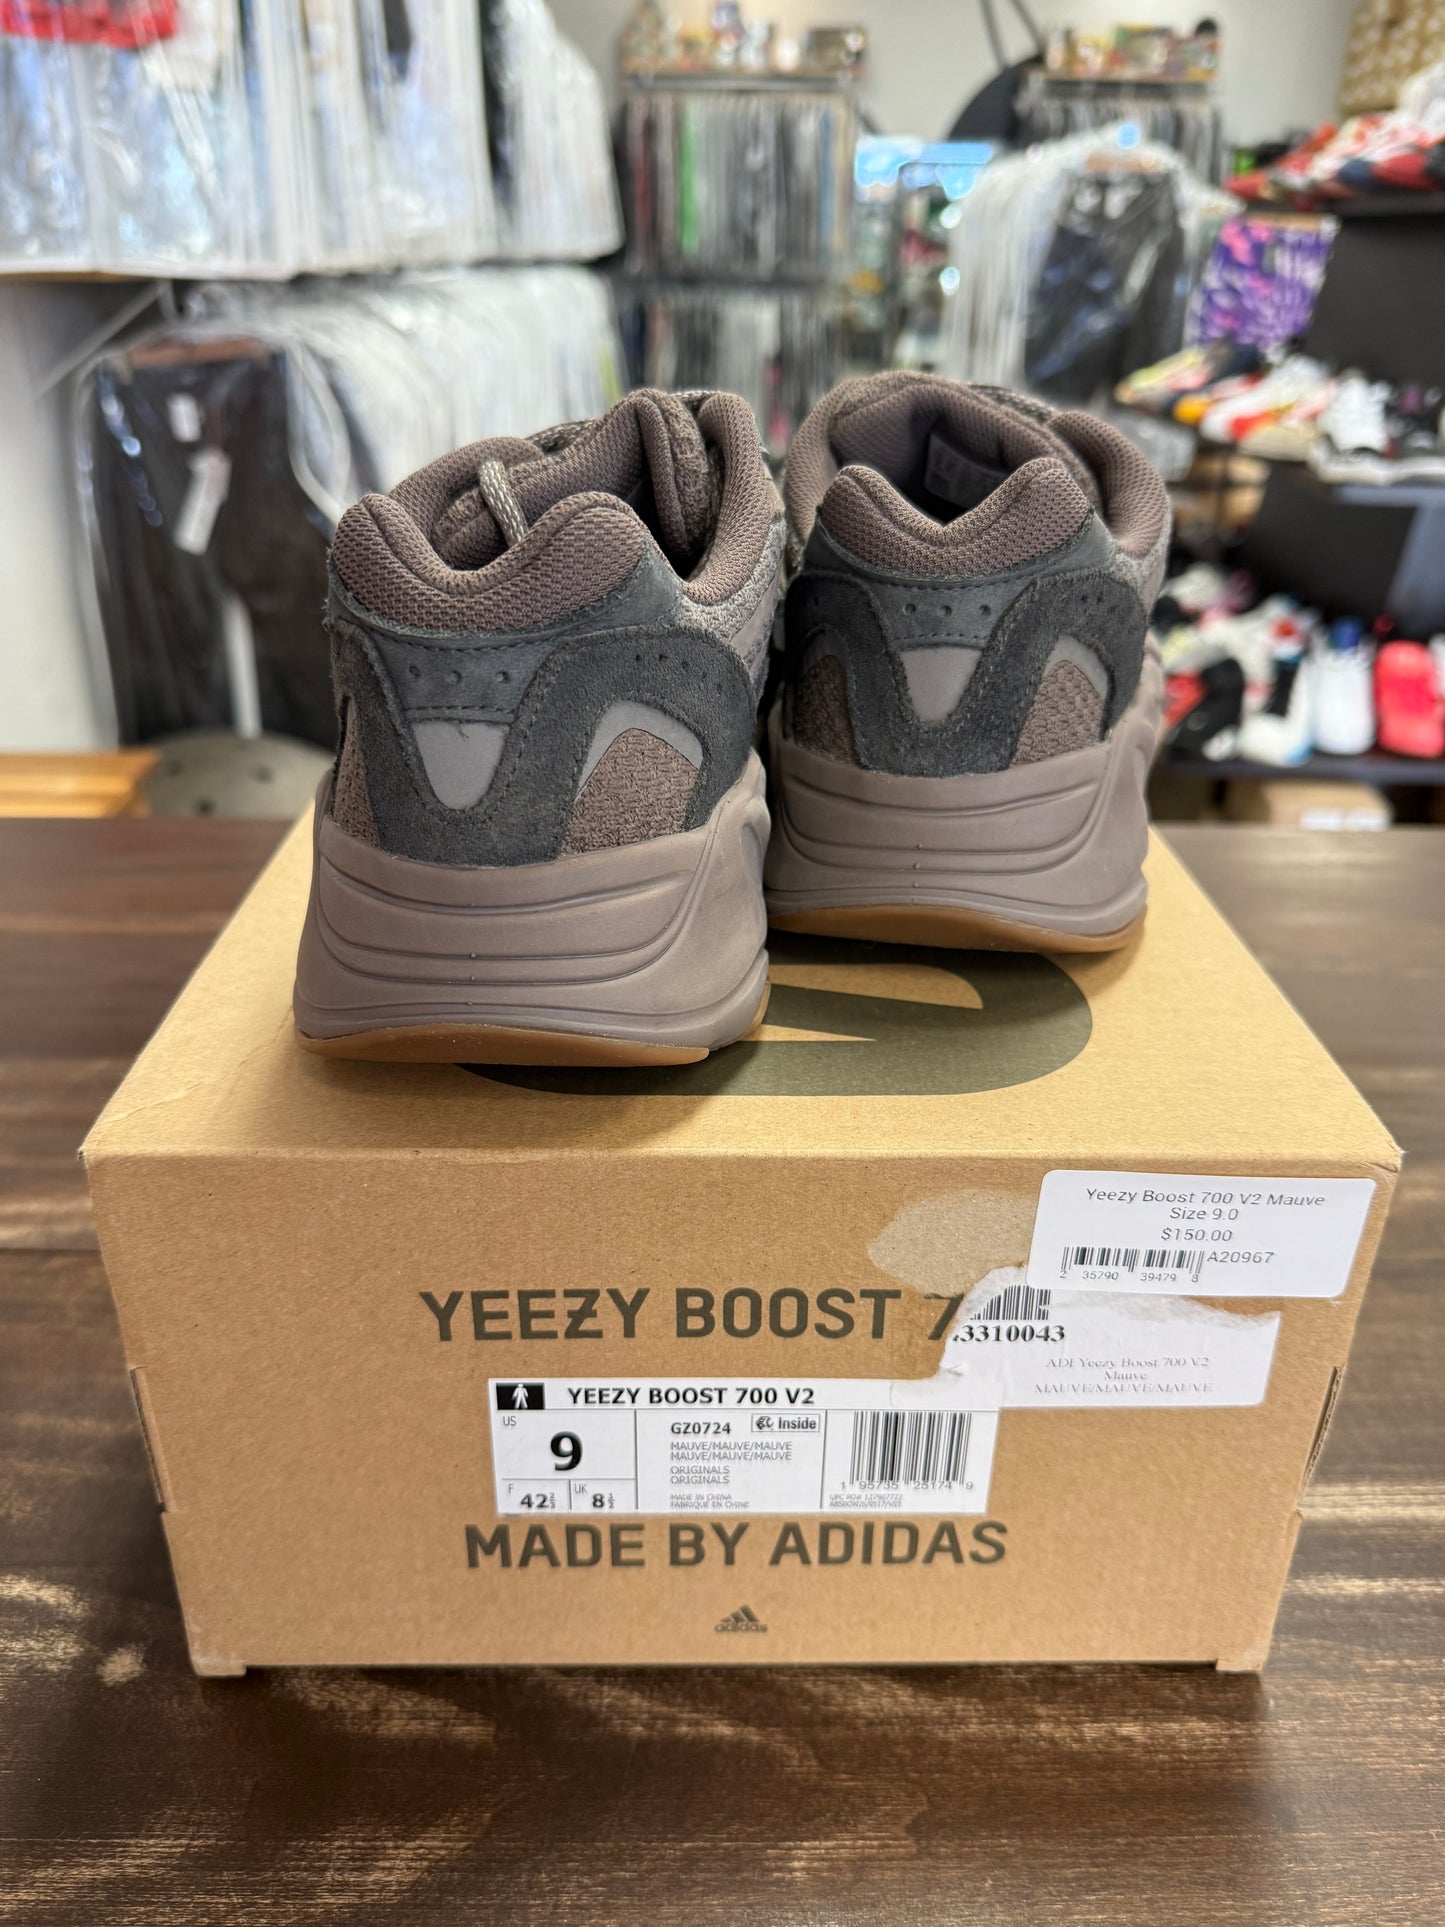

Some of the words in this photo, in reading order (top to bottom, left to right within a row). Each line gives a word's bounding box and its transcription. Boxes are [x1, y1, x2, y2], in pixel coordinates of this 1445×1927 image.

[1086, 1188, 1137, 1203] Yeezy
[1142, 1190, 1195, 1203] Boost
[1201, 1191, 1233, 1204] 700
[1239, 1193, 1261, 1205] V2
[1266, 1193, 1325, 1206] Mauve
[1169, 1207, 1207, 1220] Size
[1212, 1208, 1239, 1221] 9.0
[1161, 1227, 1233, 1242] $150.00
[1207, 1251, 1275, 1265] A20967
[1059, 1270, 1067, 1279] 2
[1082, 1271, 1119, 1281] 35790
[1140, 1273, 1177, 1282] 39479
[1191, 1274, 1199, 1282] 8
[419, 1288, 650, 1341] YEEZY
[675, 1287, 901, 1340] BOOST
[1079, 1358, 1116, 1370] Yeezy
[1121, 1358, 1159, 1368] Boost
[1162, 1358, 1186, 1368] 700
[1190, 1357, 1209, 1367] V2
[1104, 1371, 1147, 1381] Mauve
[568, 1387, 641, 1404] YEEZY
[649, 1388, 728, 1404] BOOST
[736, 1388, 777, 1404] 700
[785, 1388, 815, 1404] V2
[503, 1416, 516, 1426] US
[778, 1417, 817, 1430] Inside
[671, 1422, 731, 1435] GZ0724
[550, 1431, 583, 1471] 9
[671, 1441, 792, 1451] MAUVE/MAUVE/MAUVE
[671, 1451, 792, 1461] MAUVE/MAUVE/MAUVE
[671, 1465, 730, 1475] ORIGINALS
[671, 1475, 730, 1484] ORIGINALS
[966, 1481, 973, 1490] 9
[574, 1484, 587, 1493] UK
[464, 1523, 646, 1568] MADE
[669, 1522, 750, 1566] BY
[768, 1520, 1008, 1565] ADIDAS
